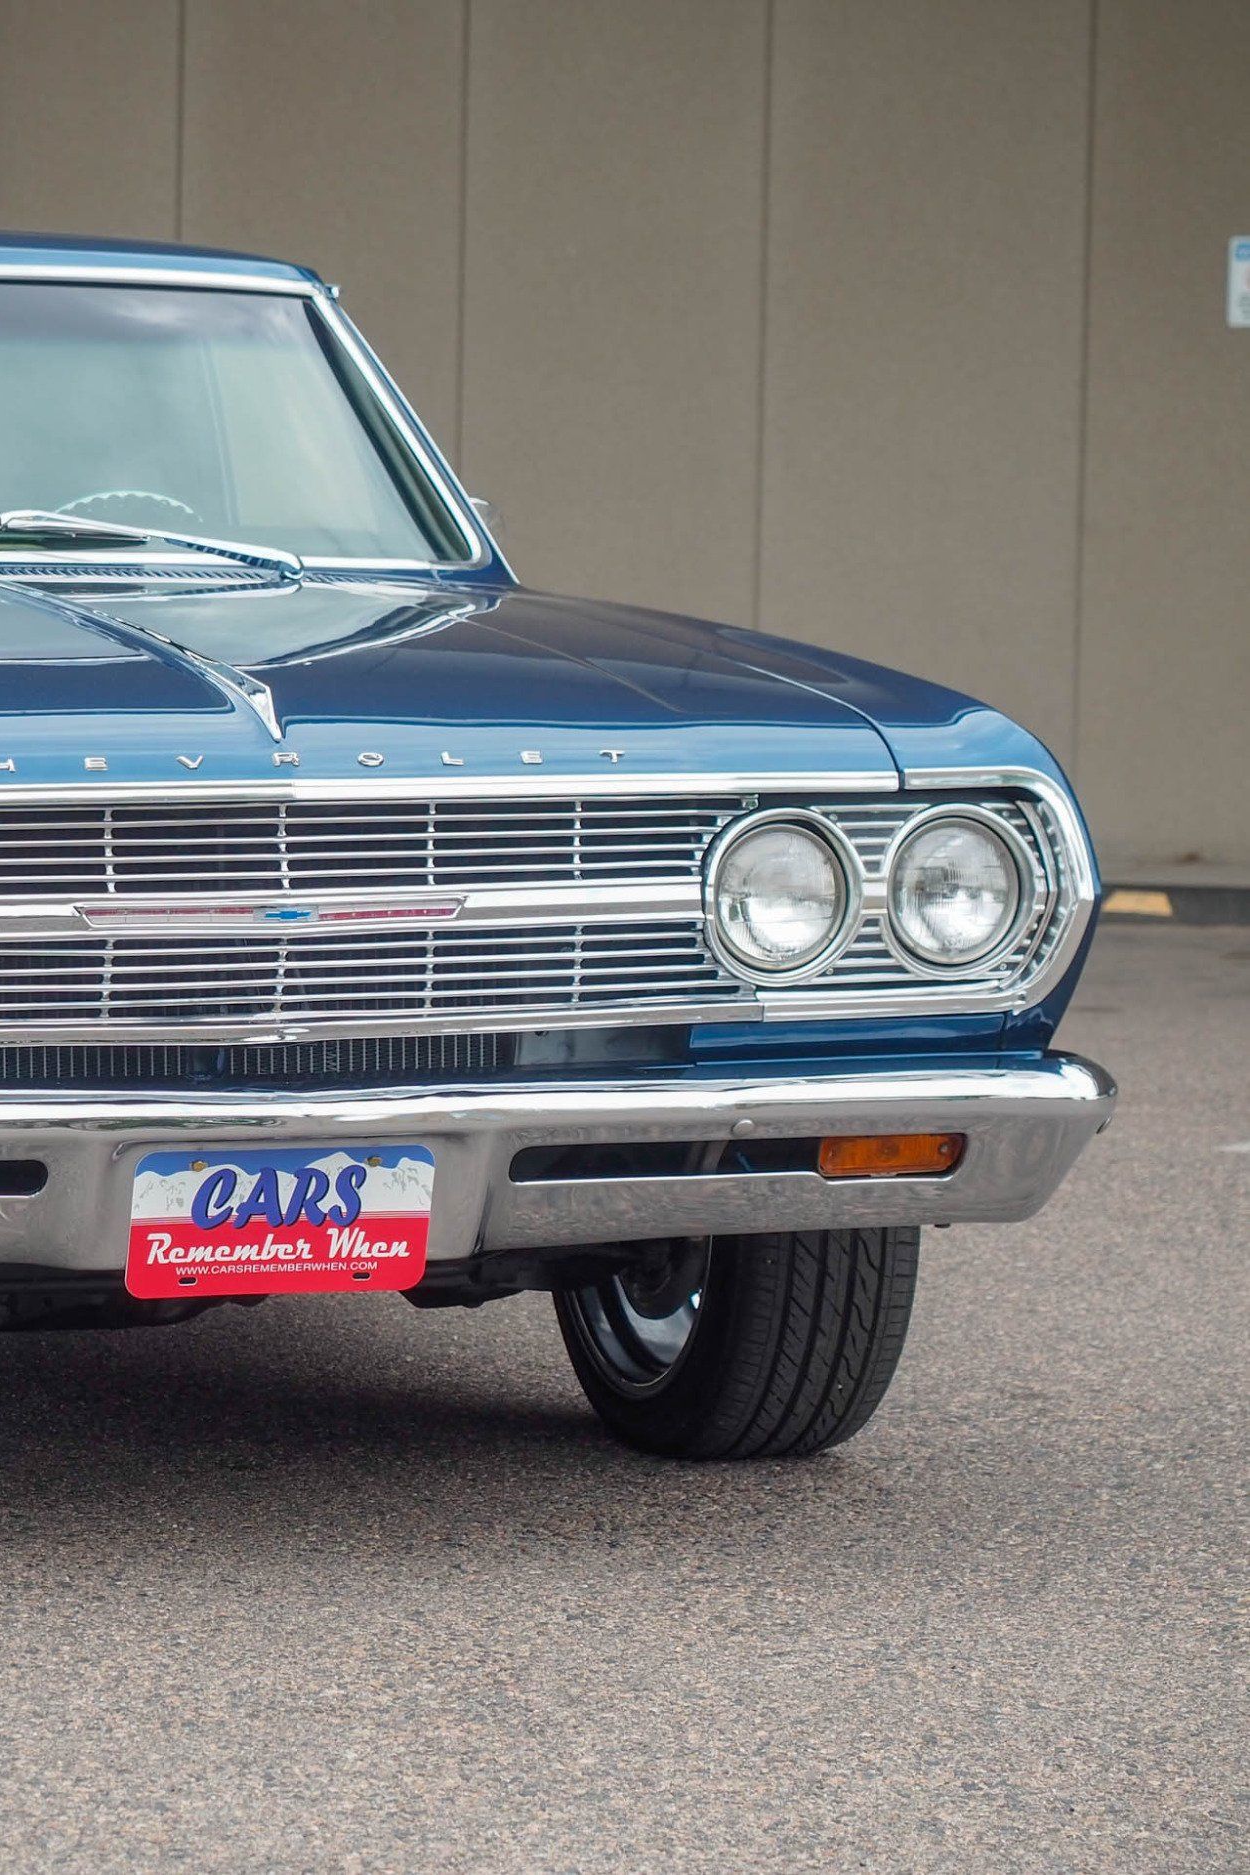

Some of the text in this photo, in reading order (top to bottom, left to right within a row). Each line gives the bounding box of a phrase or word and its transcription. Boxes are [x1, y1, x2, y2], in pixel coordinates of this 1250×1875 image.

[191, 1165, 367, 1230] CARS
[146, 1227, 410, 1265] Remember When
[176, 1261, 378, 1275] WWW.CARSREMEMBERWHEN.COM
